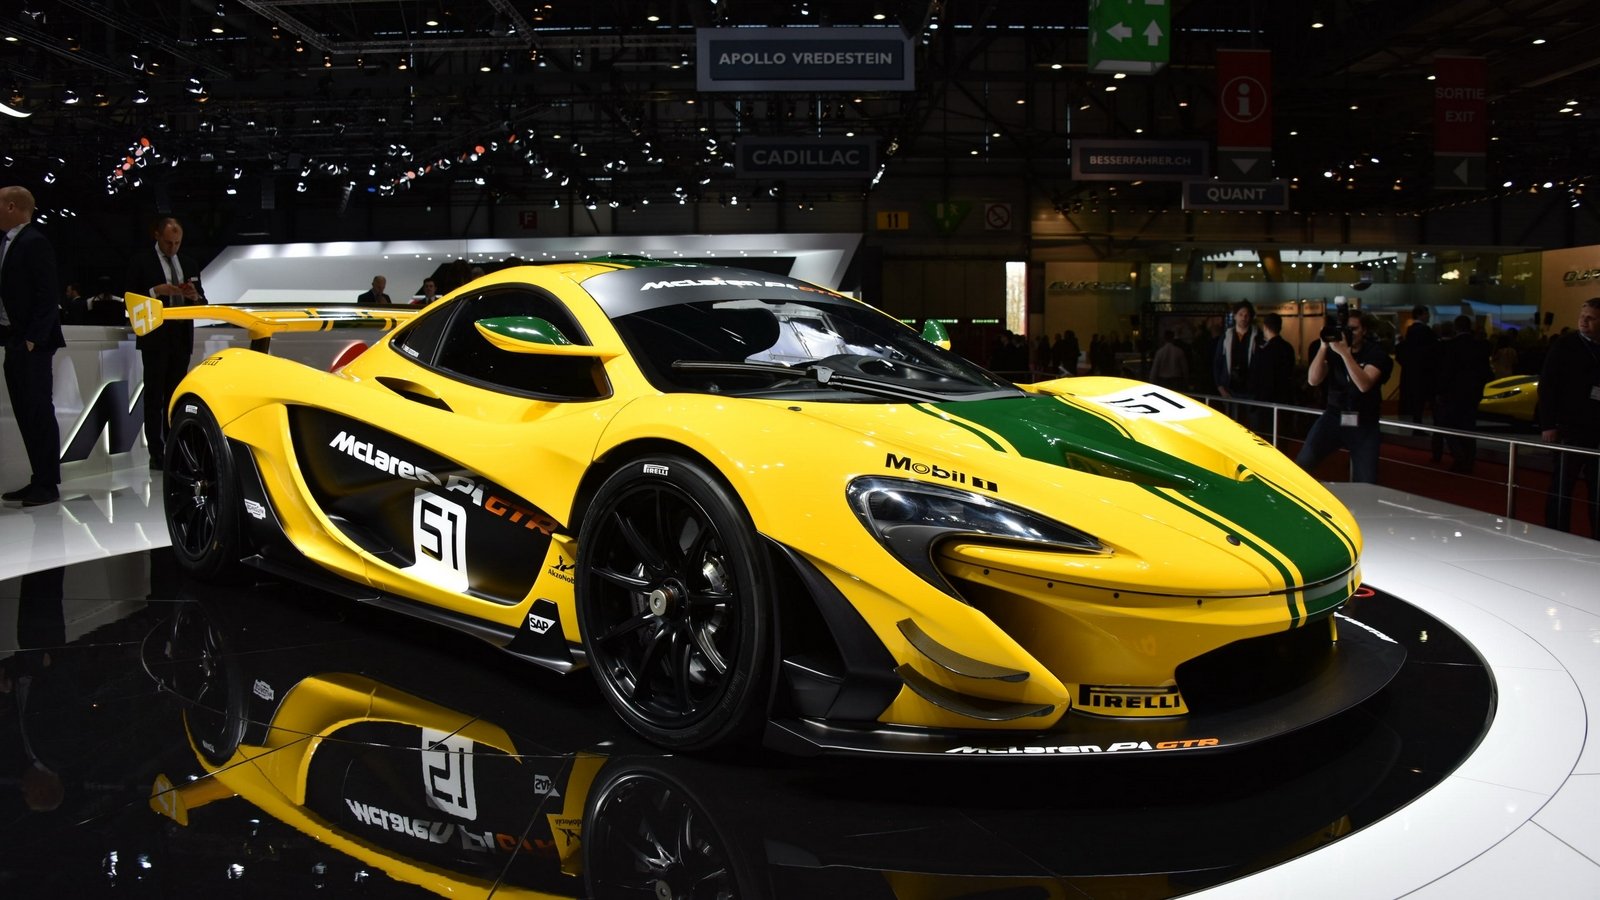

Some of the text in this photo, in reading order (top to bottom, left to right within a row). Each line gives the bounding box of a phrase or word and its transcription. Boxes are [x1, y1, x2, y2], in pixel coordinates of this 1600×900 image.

[718, 52, 893, 65] APOLLO VREDESTEIN
[1434, 87, 1486, 100] SORTIE
[1444, 110, 1476, 123] EXIT
[752, 150, 861, 166] CADILLAC
[1089, 155, 1191, 166] BESSERFAHRER.CH
[1206, 187, 1267, 202] QUANT
[887, 213, 899, 228] 11
[640, 277, 762, 291] McLaren
[1101, 391, 1186, 414] 51
[643, 463, 669, 476] PIRELLI
[885, 453, 966, 484] Mobil
[329, 431, 442, 486] McLaren
[483, 496, 559, 536] GTR
[420, 498, 460, 572] 51
[529, 617, 549, 631] SAP
[1078, 684, 1180, 708] PIRELLI
[945, 745, 1102, 754] McLaren
[1155, 738, 1220, 750] GTR
